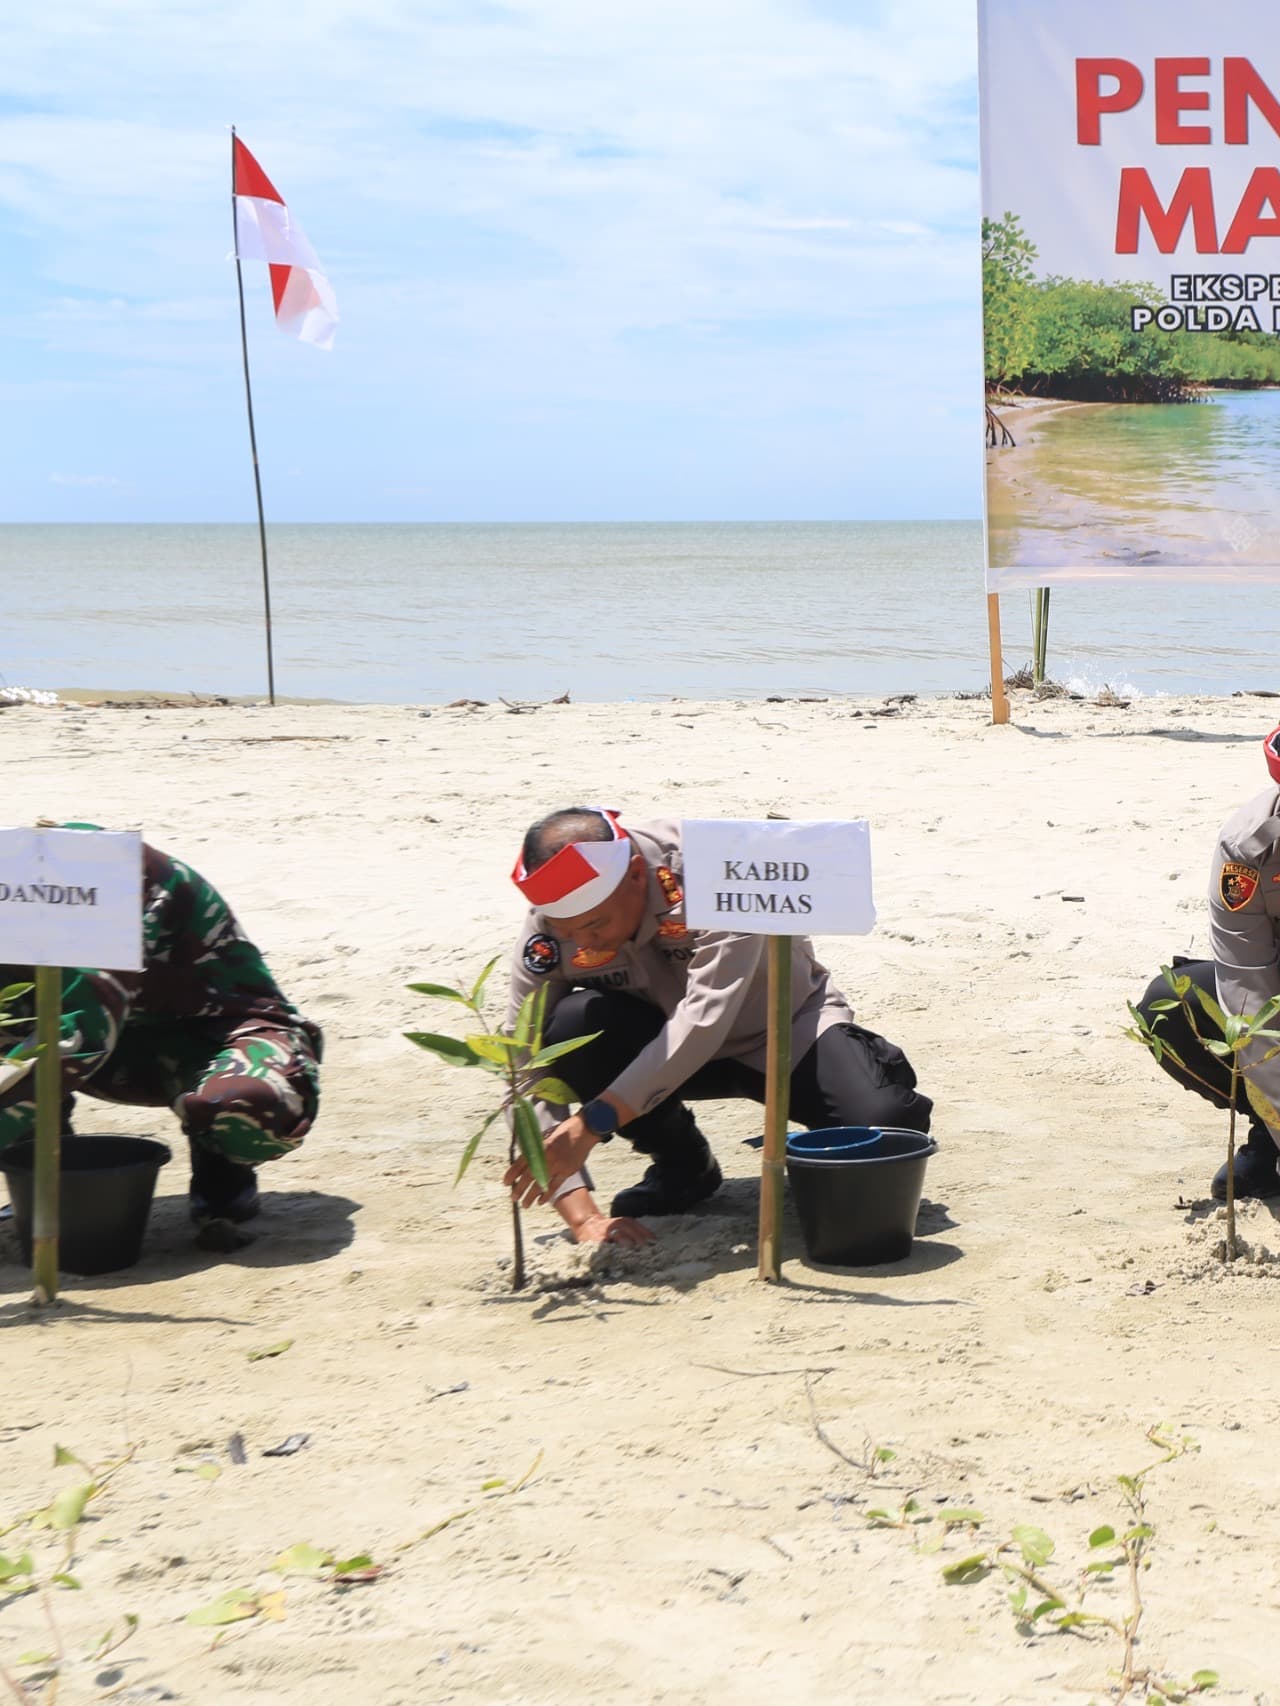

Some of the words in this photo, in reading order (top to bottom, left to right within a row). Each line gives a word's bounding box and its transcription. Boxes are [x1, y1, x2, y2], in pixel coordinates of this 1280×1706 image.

[1131, 304, 1261, 332] POLDA
[724, 860, 810, 882] KABID
[715, 892, 813, 914] HUMAS
